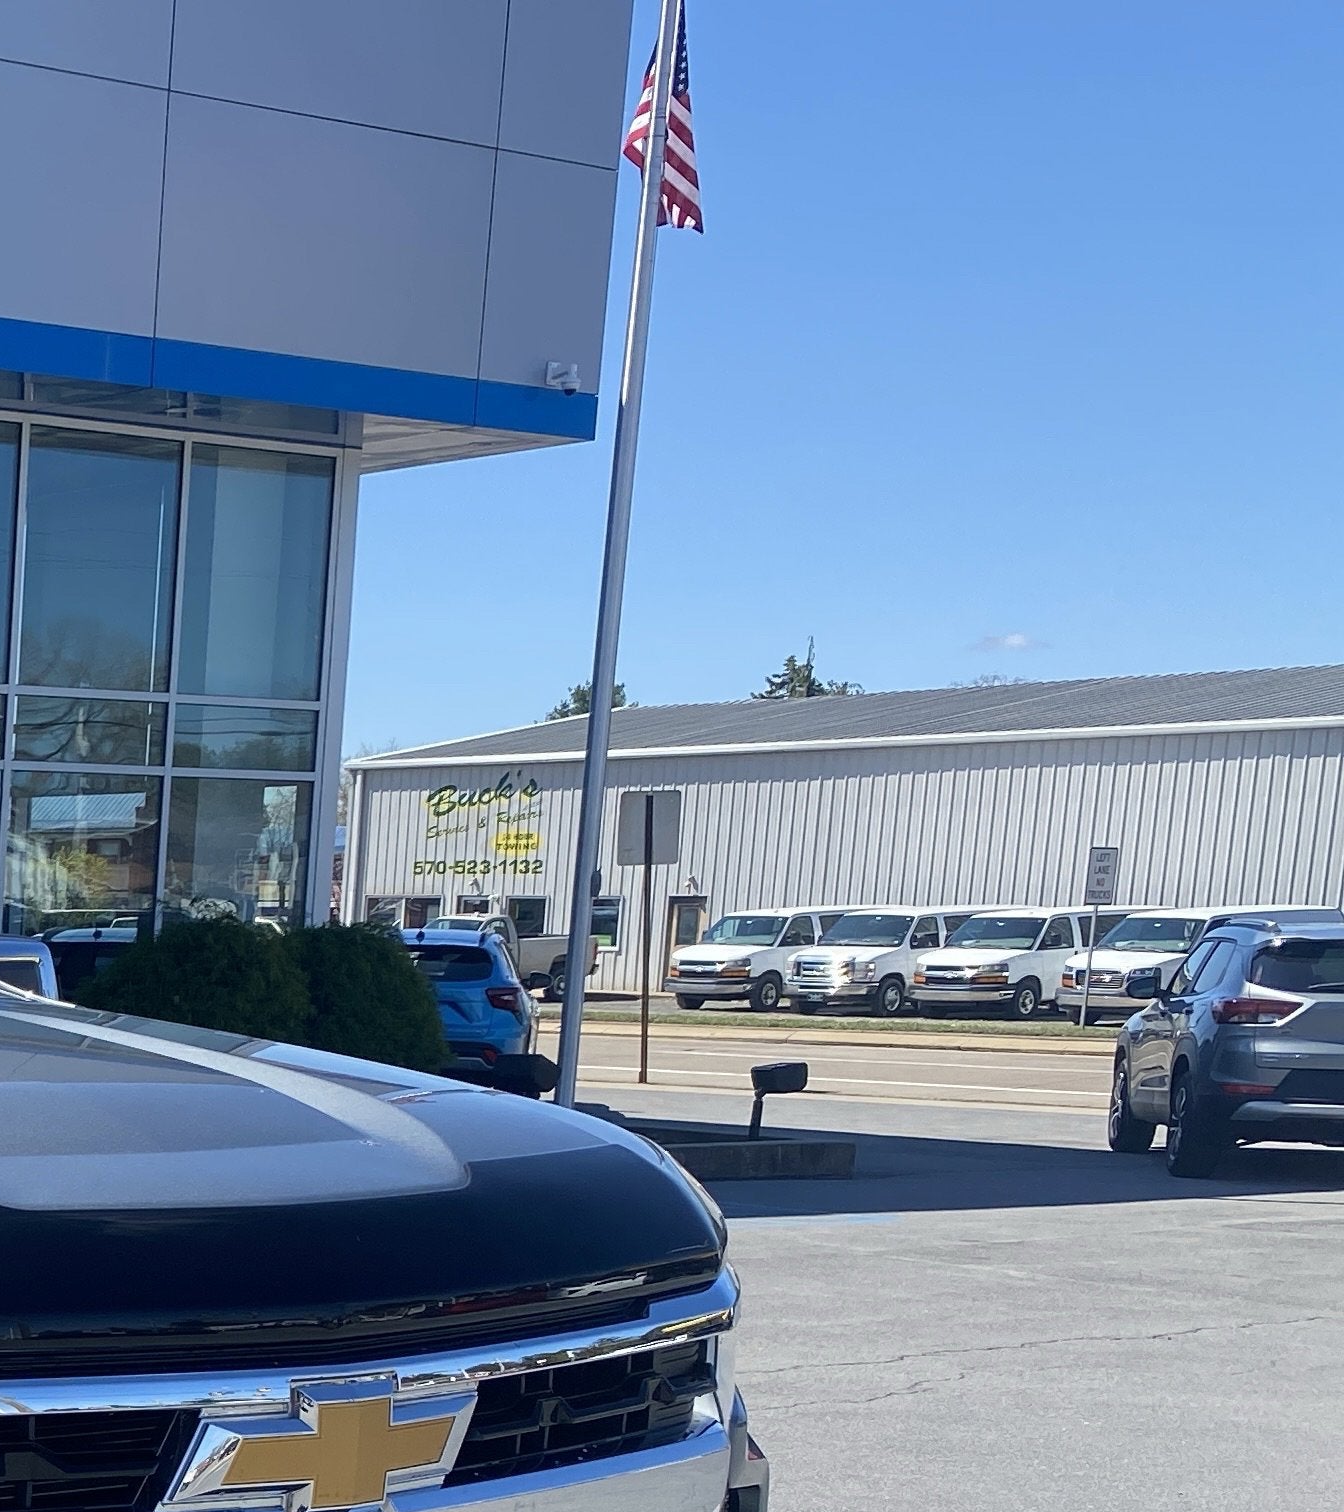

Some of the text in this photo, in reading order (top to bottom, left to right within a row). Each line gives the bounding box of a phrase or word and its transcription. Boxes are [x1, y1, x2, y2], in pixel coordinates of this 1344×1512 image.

[427, 770, 543, 816] Buck's
[496, 842, 538, 851] TOWING
[413, 859, 544, 875] 570-523-1132
